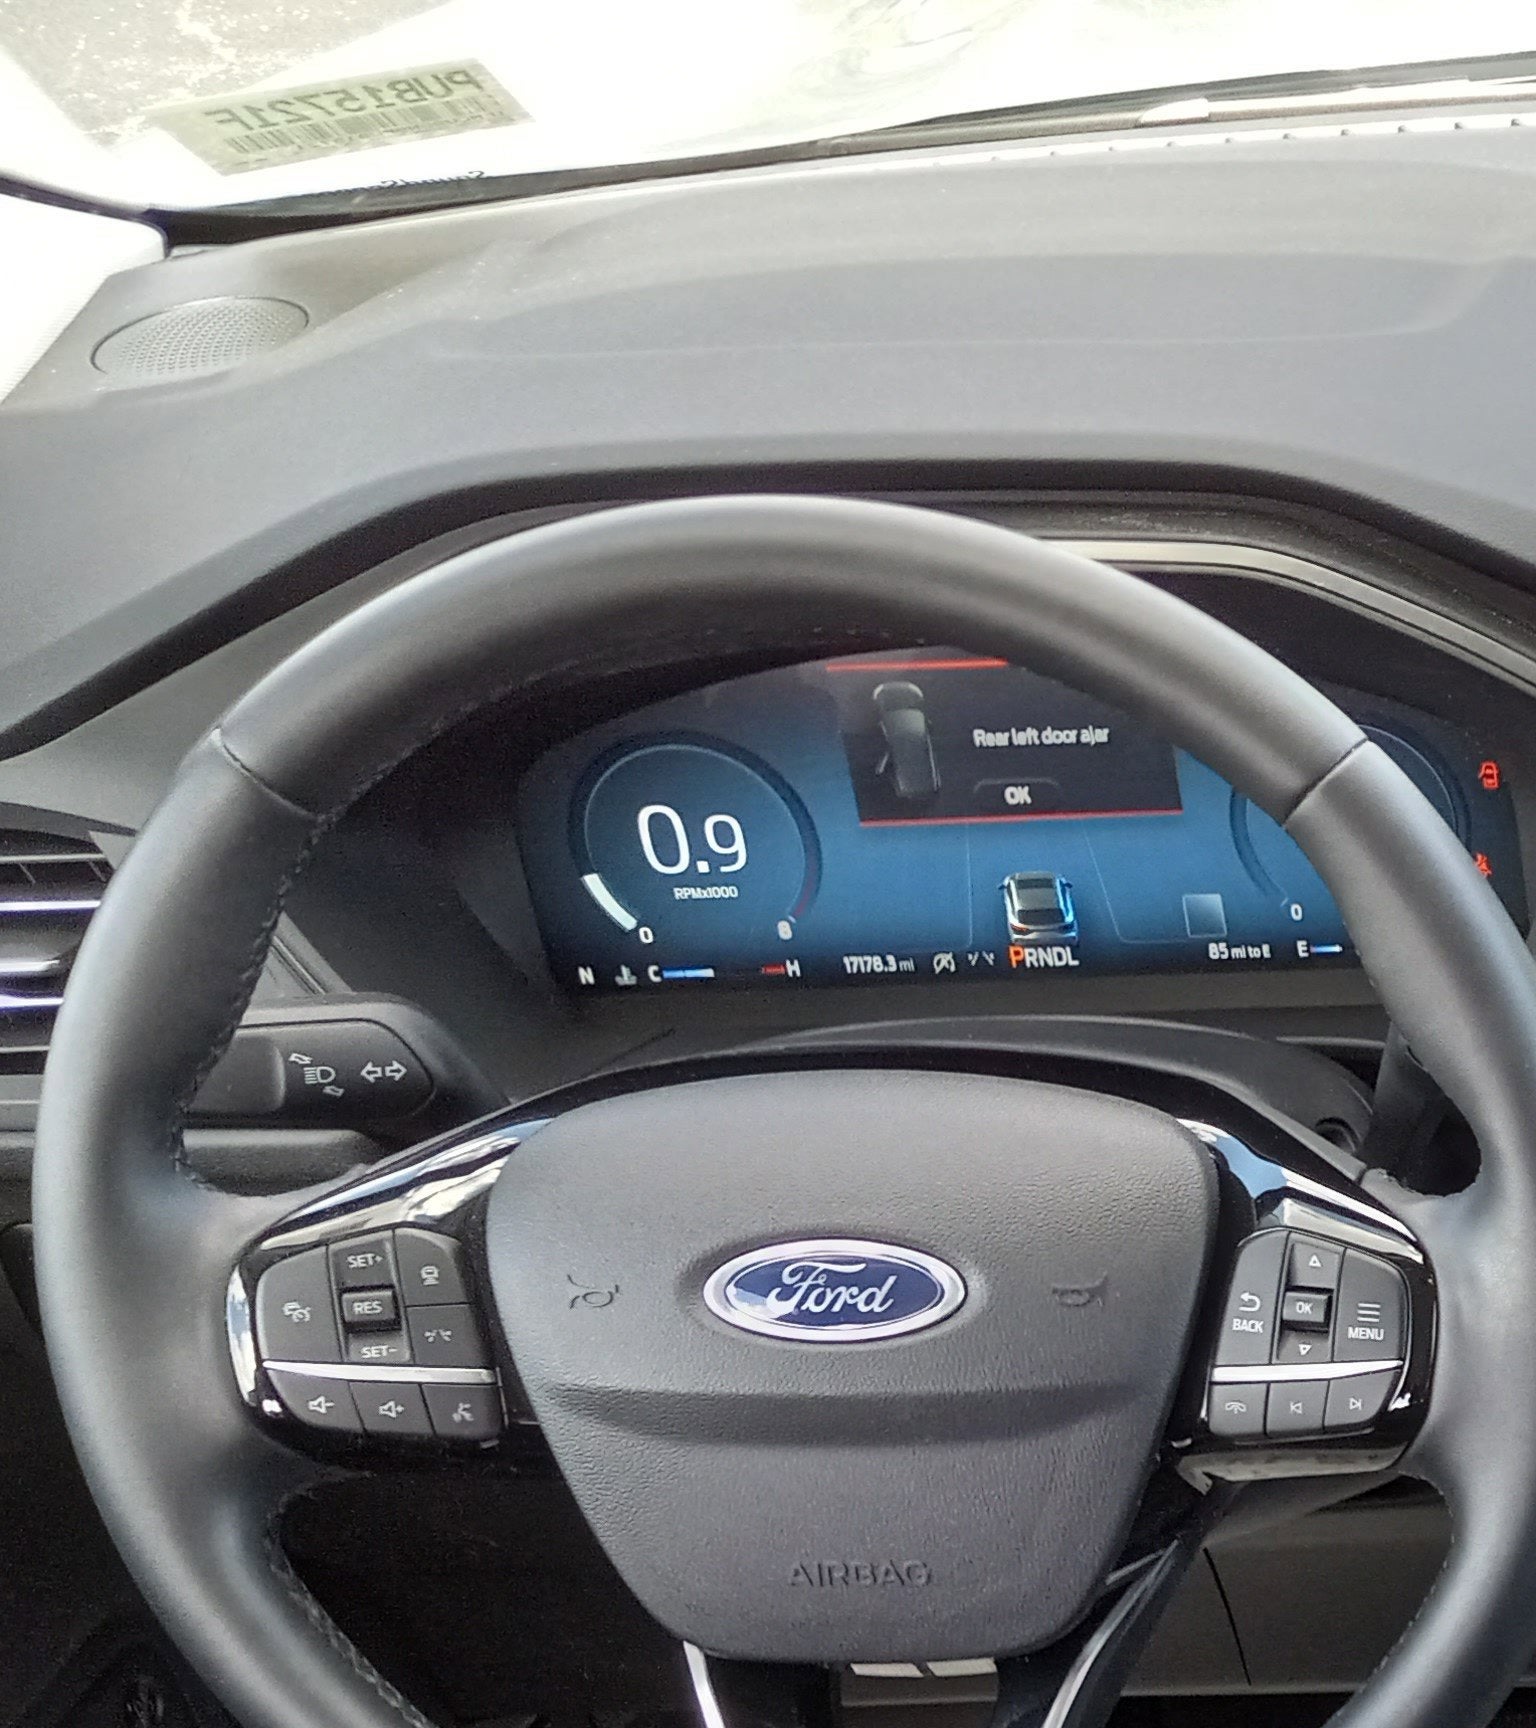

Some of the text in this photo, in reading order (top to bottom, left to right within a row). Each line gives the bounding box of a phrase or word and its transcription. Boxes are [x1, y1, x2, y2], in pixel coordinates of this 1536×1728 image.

[973, 725, 1110, 748] Rear left door ajar
[1004, 786, 1032, 804] OK
[637, 804, 748, 875] 0.9
[673, 885, 739, 900] RPMx1000
[1290, 904, 1303, 921] 0
[639, 926, 654, 944] 0
[1208, 942, 1229, 960] 85
[1230, 944, 1246, 959] mi
[1247, 944, 1261, 959] to
[1296, 940, 1309, 958] E
[785, 958, 801, 978] H
[843, 954, 915, 974] 17178.3 mi
[578, 965, 595, 985] N
[648, 964, 662, 983] C
[766, 1260, 897, 1316] Ford
[353, 1300, 383, 1315] RES
[1296, 1301, 1312, 1314] OK
[1232, 1319, 1263, 1333] BACK
[1348, 1327, 1385, 1341] MENU
[791, 1559, 933, 1588] AIRBAG
